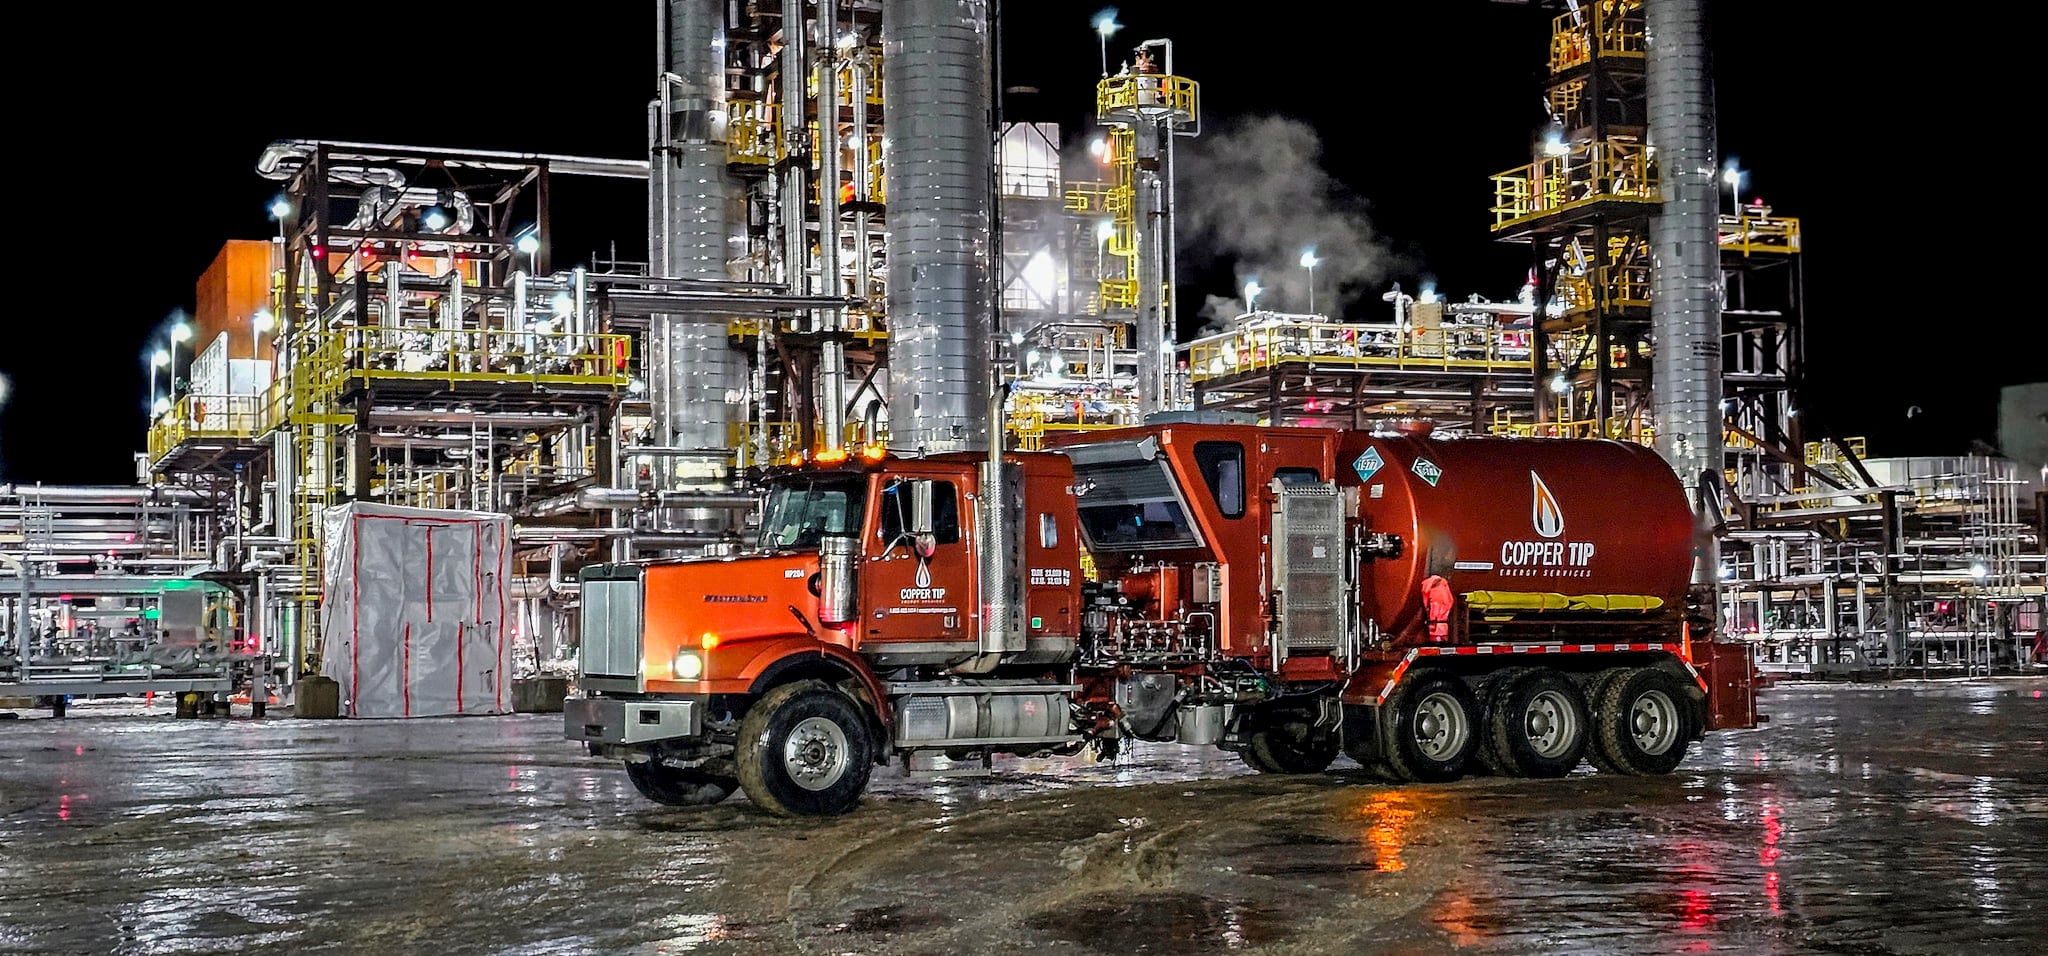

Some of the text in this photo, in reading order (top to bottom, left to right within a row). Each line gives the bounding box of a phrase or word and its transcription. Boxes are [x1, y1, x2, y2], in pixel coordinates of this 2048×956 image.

[1358, 459, 1378, 470] 1977
[1501, 541, 1595, 566] COPPER TIP
[1499, 568, 1591, 577] ENERGY SERVICES
[900, 588, 946, 600] COPPER TIP
